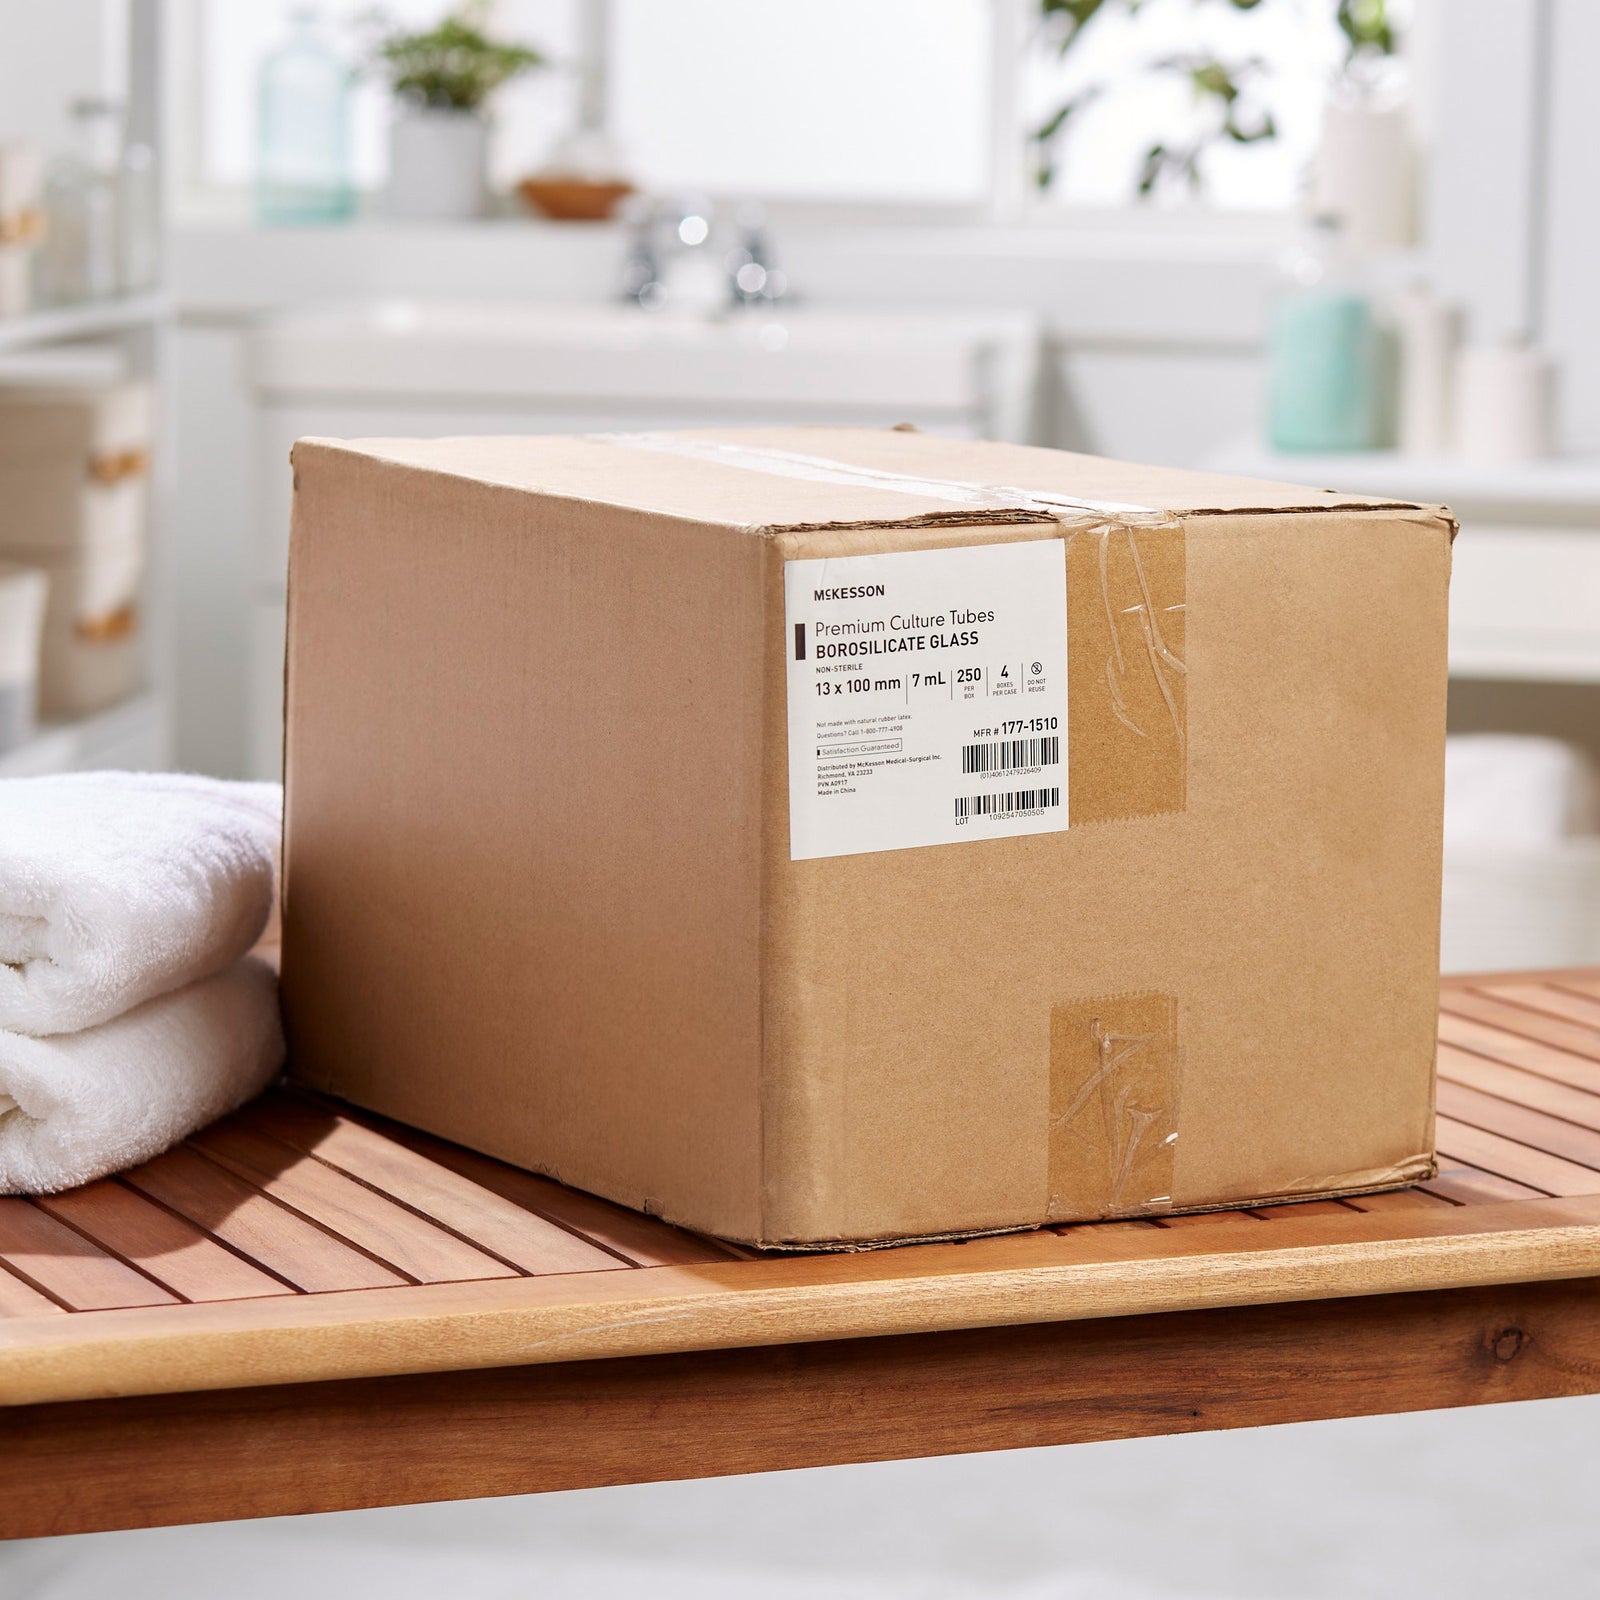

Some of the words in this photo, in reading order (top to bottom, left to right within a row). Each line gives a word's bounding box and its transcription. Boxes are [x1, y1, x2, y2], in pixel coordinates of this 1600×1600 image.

[816, 619, 885, 637] Premium
[890, 614, 945, 630] Culture
[949, 609, 995, 625] Tubes
[816, 636, 926, 659] BOROSILICATE
[930, 631, 979, 649] GLASS
[816, 663, 863, 674] NON-STERILE
[957, 667, 982, 683] 250
[1000, 665, 1009, 679] 4
[912, 673, 920, 688] 7
[924, 671, 946, 686] mL
[996, 681, 1014, 689] BOXES
[816, 682, 830, 696] 13
[834, 684, 842, 695] x
[846, 678, 870, 693] 100
[874, 678, 900, 691] mm
[856, 717, 877, 725] natural
[878, 715, 897, 723] rubber
[973, 728, 992, 738] MFR
[993, 728, 1000, 736] #
[1001, 716, 1058, 735] 177-1510
[816, 730, 848, 740] Questions?
[848, 729, 859, 737] Call
[860, 725, 904, 735] 1-800-777-4908
[822, 746, 860, 756] Satisfaction
[860, 742, 900, 752] Guaranteed
[817, 763, 848, 772] Distributed
[848, 761, 856, 770] by
[856, 760, 885, 768] McKesson
[885, 755, 931, 765] Medical-Surgical
[817, 771, 847, 780] Richmond,
[955, 816, 970, 826] LOT
[989, 809, 1046, 821] 1092547050505
